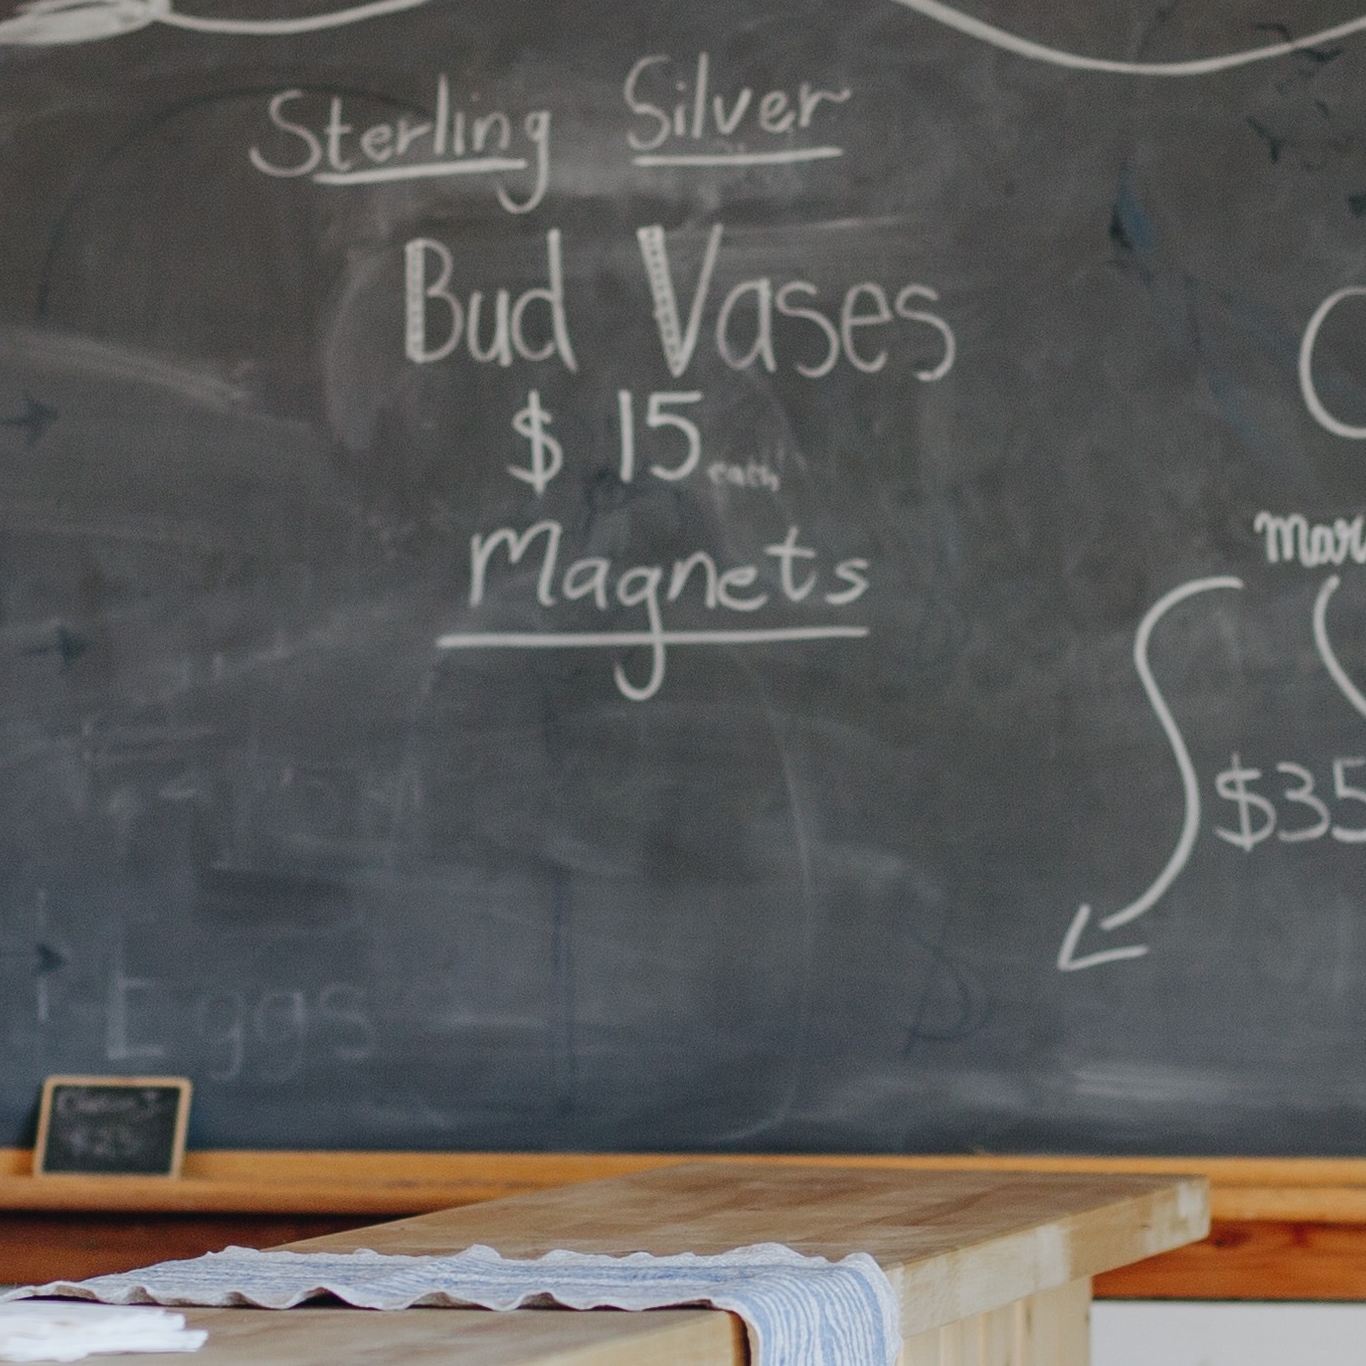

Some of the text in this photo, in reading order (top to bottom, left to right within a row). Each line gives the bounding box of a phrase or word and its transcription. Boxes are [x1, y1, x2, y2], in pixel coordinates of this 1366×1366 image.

[249, 50, 852, 214] Sterling Silver
[404, 222, 958, 382] Bud Vases
[468, 519, 870, 702] Magnets
